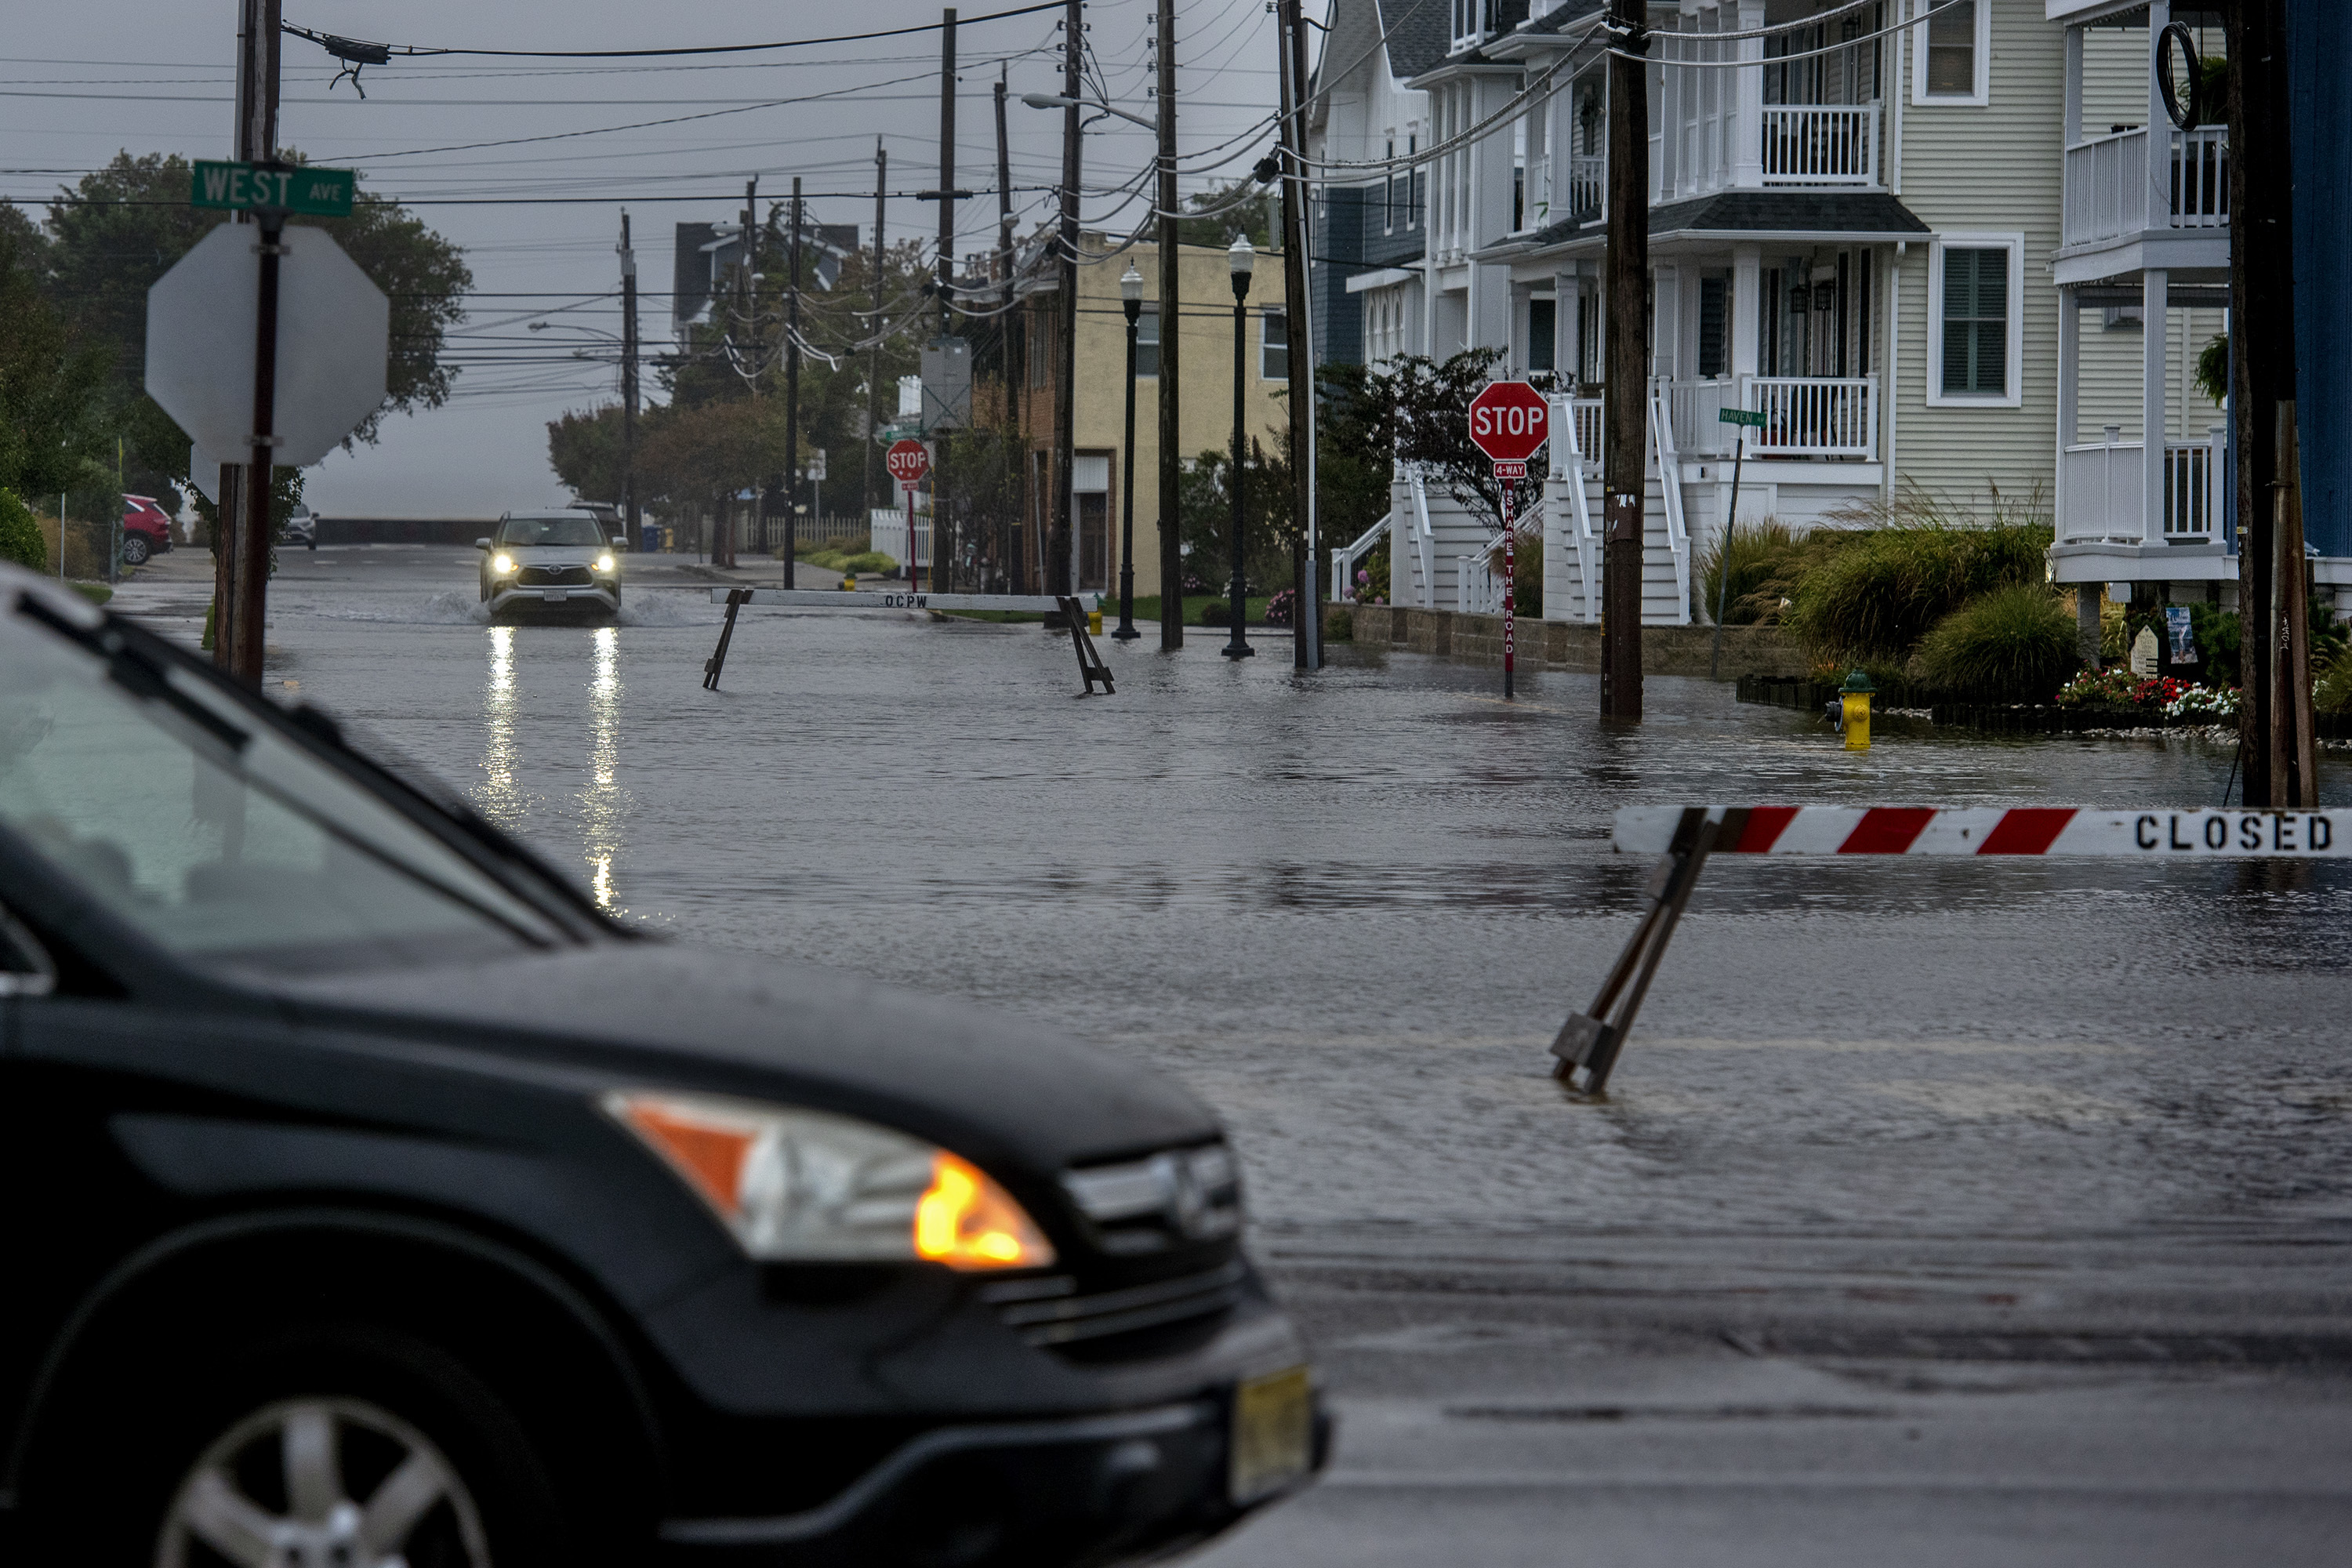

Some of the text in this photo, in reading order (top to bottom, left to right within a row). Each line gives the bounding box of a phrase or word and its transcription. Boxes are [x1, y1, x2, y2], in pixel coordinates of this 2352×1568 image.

[202, 167, 343, 206] WEST AVE
[1475, 405, 1544, 436] STOP
[1721, 410, 1753, 423] HAVEN
[889, 452, 926, 470] STOP
[1496, 465, 1524, 475] 4-WAY
[885, 595, 927, 608] OCPW
[2136, 815, 2332, 851] CLOSED
